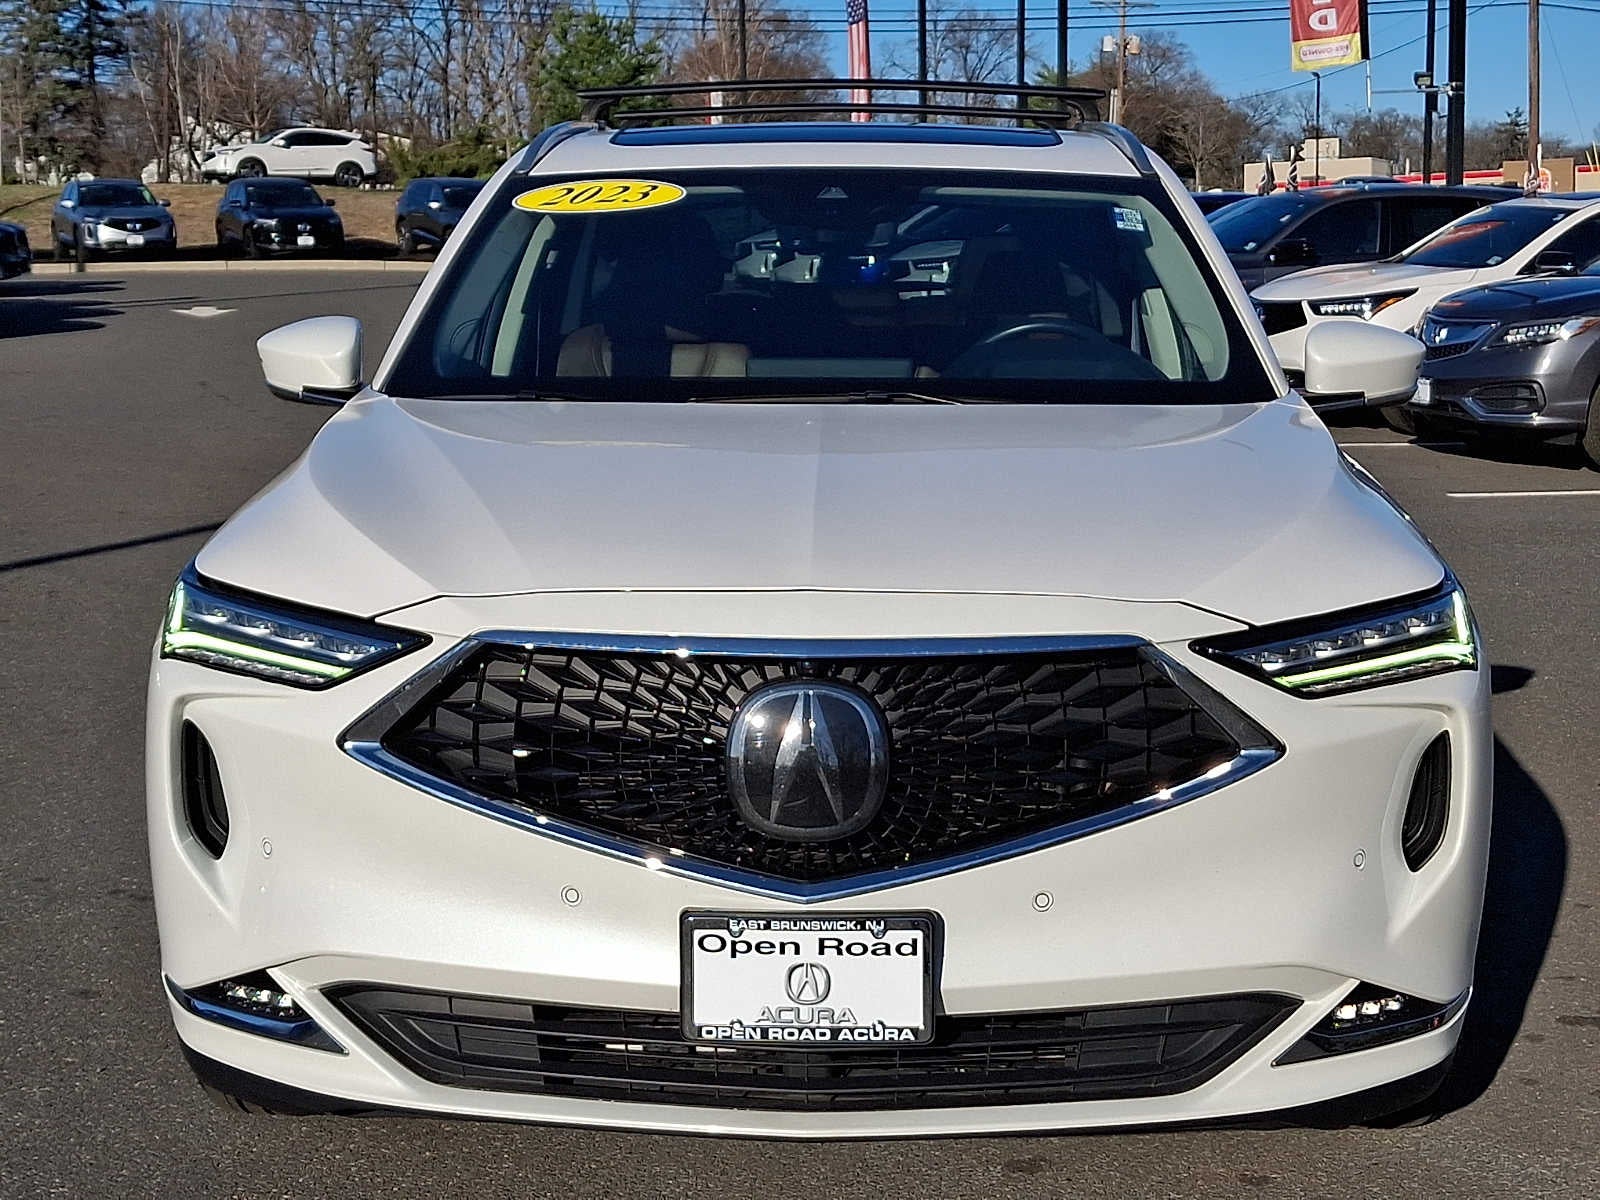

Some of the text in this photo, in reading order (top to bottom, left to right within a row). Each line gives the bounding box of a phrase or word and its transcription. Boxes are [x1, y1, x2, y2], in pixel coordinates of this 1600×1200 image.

[538, 184, 659, 207] 2023
[729, 919, 767, 930] EAST
[865, 920, 885, 931] NJ
[698, 934, 918, 958] Open Road
[755, 1006, 858, 1025] ACURA
[701, 1026, 916, 1041] OPEN ROAD ACURA
